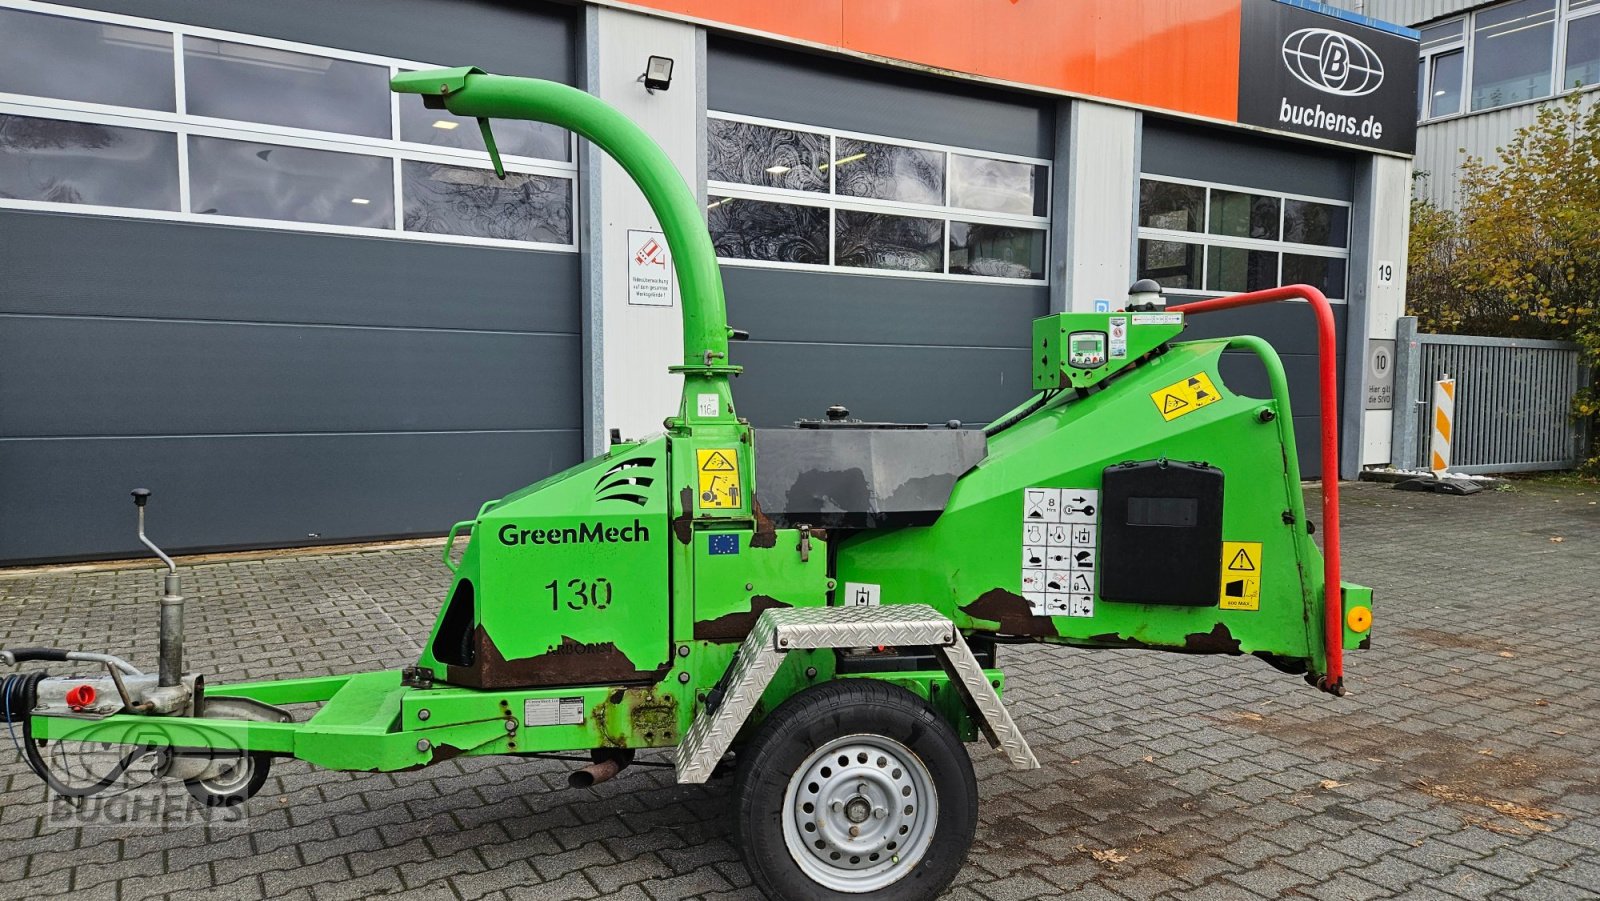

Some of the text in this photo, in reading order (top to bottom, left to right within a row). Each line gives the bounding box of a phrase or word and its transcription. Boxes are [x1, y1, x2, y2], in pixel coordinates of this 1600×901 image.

[1322, 42, 1348, 80] B
[1280, 97, 1383, 140] buchens.de
[1378, 264, 1392, 281] 19
[1376, 355, 1386, 370] 10
[1048, 498, 1055, 506] 8
[498, 518, 650, 546] GreenMech
[545, 577, 612, 611] 130
